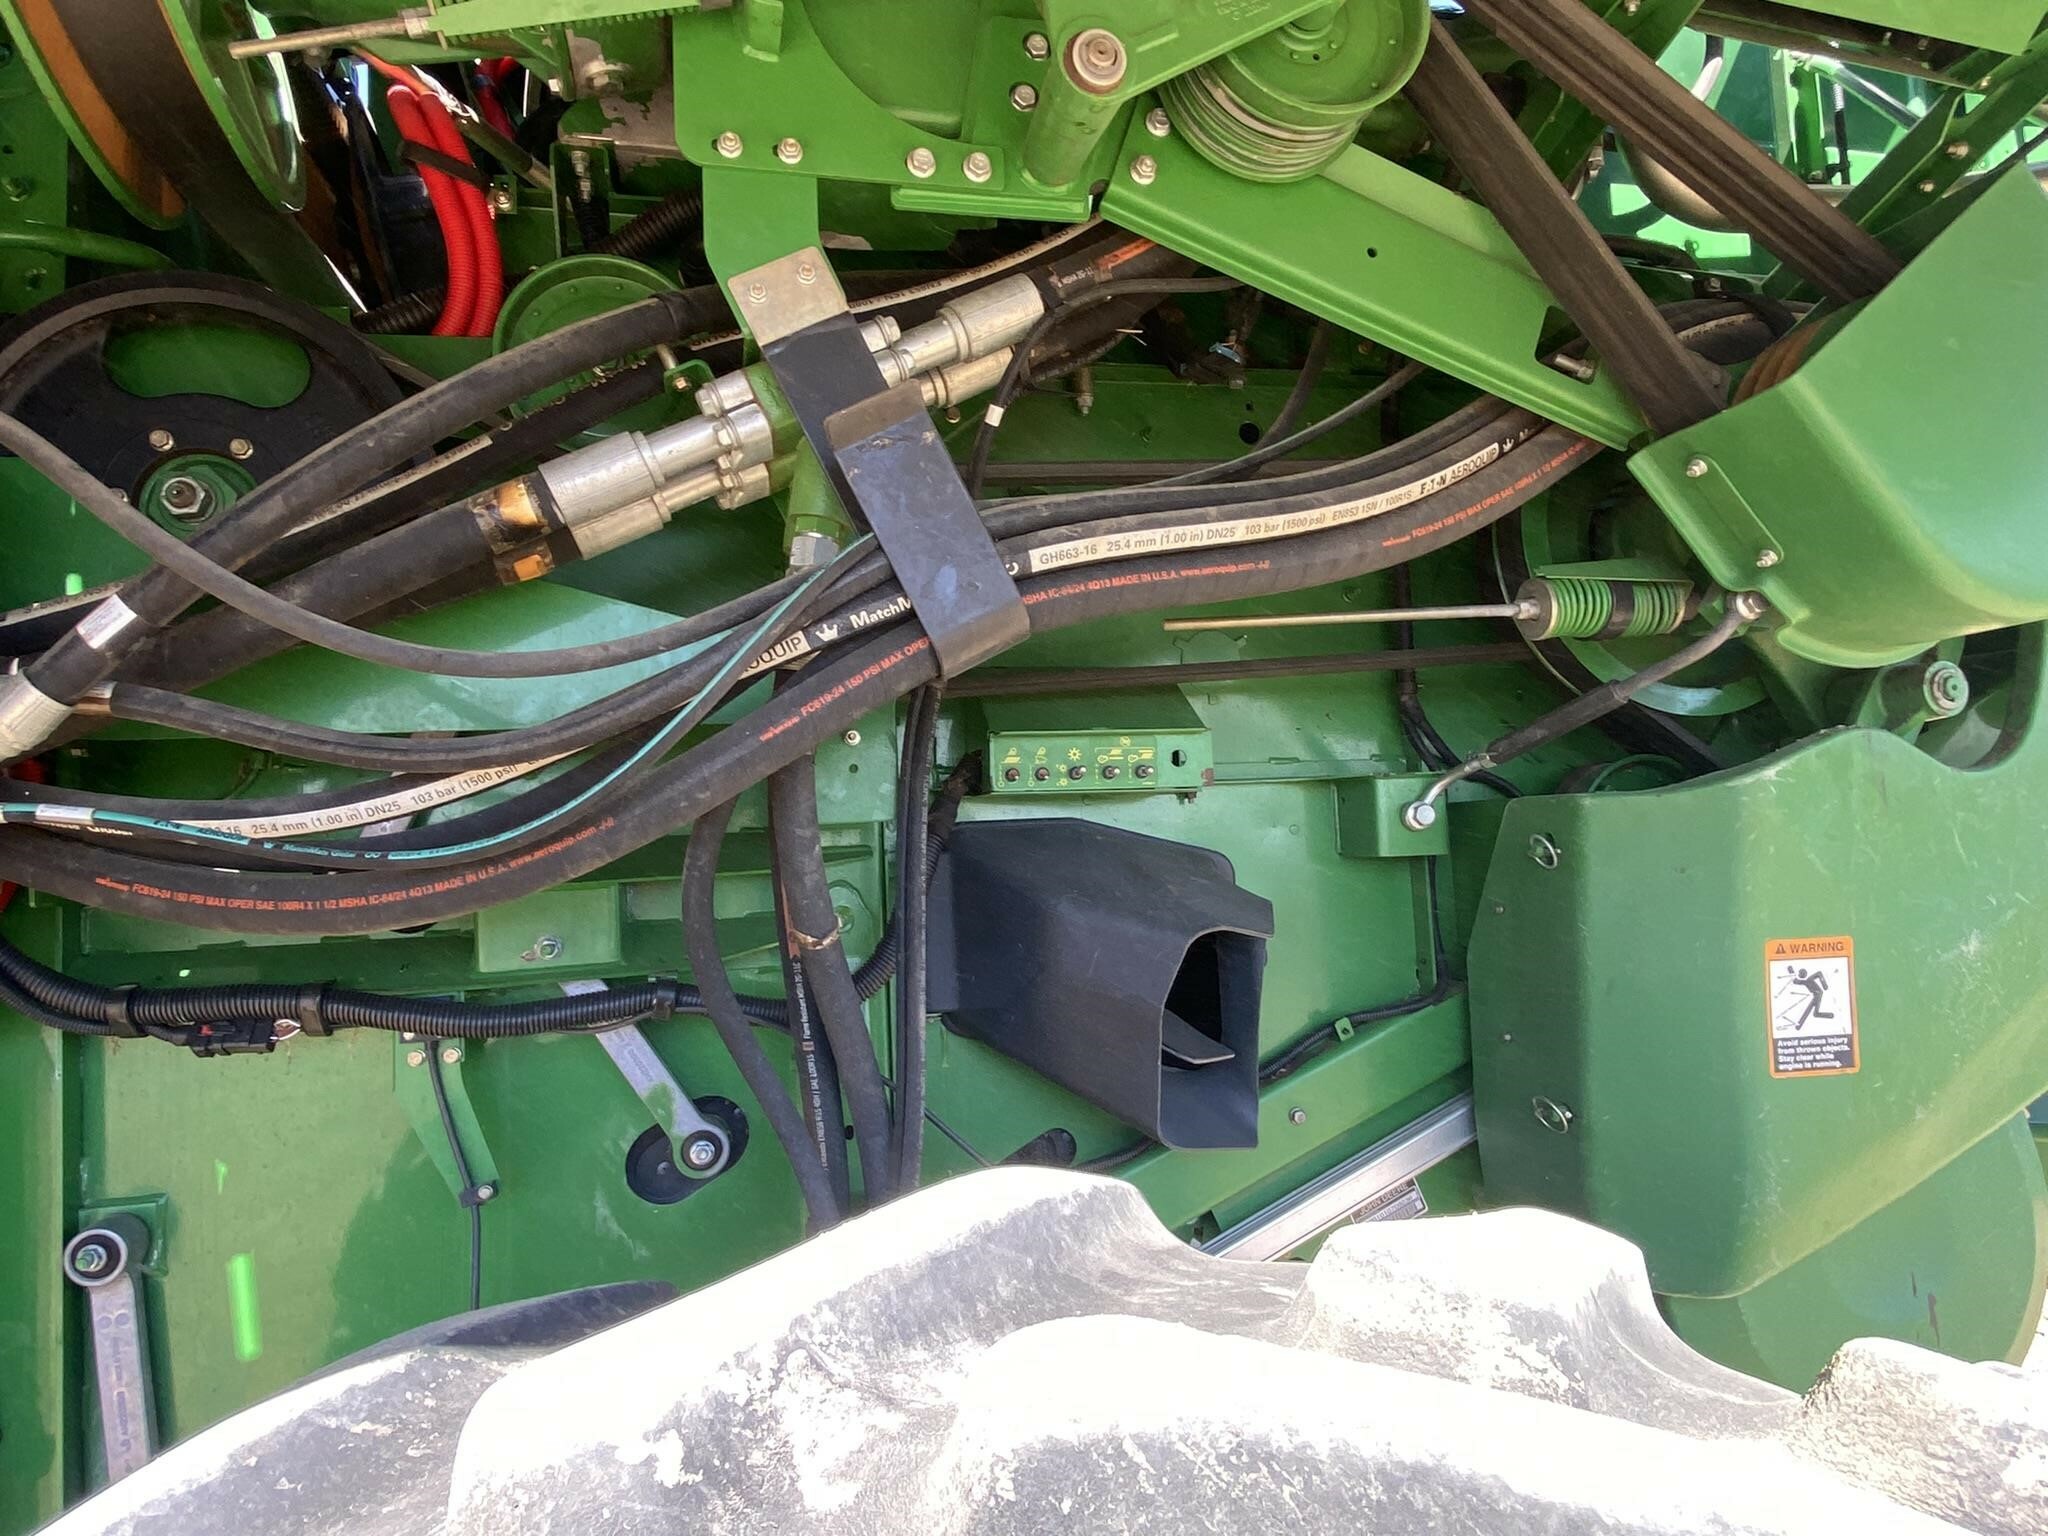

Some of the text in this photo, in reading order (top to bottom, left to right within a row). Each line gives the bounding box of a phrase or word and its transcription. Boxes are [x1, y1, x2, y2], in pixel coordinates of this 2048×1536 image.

[1040, 544, 1098, 565] GH663-16
[1107, 539, 1132, 553] 25.4
[1134, 537, 1157, 549] mm
[1160, 531, 1187, 546] (1.00
[1190, 531, 1204, 543] in)
[1207, 526, 1236, 540] DN25
[1245, 523, 1262, 536] 103
[1263, 520, 1280, 533] bar
[1282, 517, 1308, 532] (1500
[1308, 513, 1326, 528] psi)
[1332, 506, 1360, 521] EN853
[1451, 446, 1498, 483] AEROQUIP
[1112, 574, 1139, 587] MADE
[1140, 572, 1151, 582] IN
[845, 674, 864, 690] 150
[863, 667, 881, 680] PSI
[881, 652, 905, 671] MAX
[251, 823, 279, 835] 25.4
[282, 822, 309, 833] mm
[311, 813, 343, 829] (1.00
[345, 807, 364, 822] in)
[366, 801, 401, 818] DN25
[410, 791, 434, 806] 103
[434, 785, 458, 800] bar
[458, 771, 494, 793] (1500
[494, 763, 519, 781] psi)
[205, 895, 227, 908] MAX
[227, 898, 255, 909] OPER
[255, 899, 275, 911] SAE
[338, 896, 367, 909] MSHA
[434, 875, 465, 893] MADE
[464, 872, 478, 885] IN
[508, 826, 597, 869] www.aeroquip.com
[1789, 941, 1844, 954] WARNING
[1777, 1036, 1848, 1047] Avoid serious injury
[1777, 1047, 1795, 1055] from
[1796, 1046, 1821, 1054] thrown
[1778, 1055, 1795, 1064] Stay
[1815, 1052, 1835, 1060] while
[1778, 1063, 1804, 1071] engine
[1804, 1061, 1812, 1069] is
[1359, 1198, 1383, 1216] JOHN
[1382, 1182, 1409, 1202] DEERE
